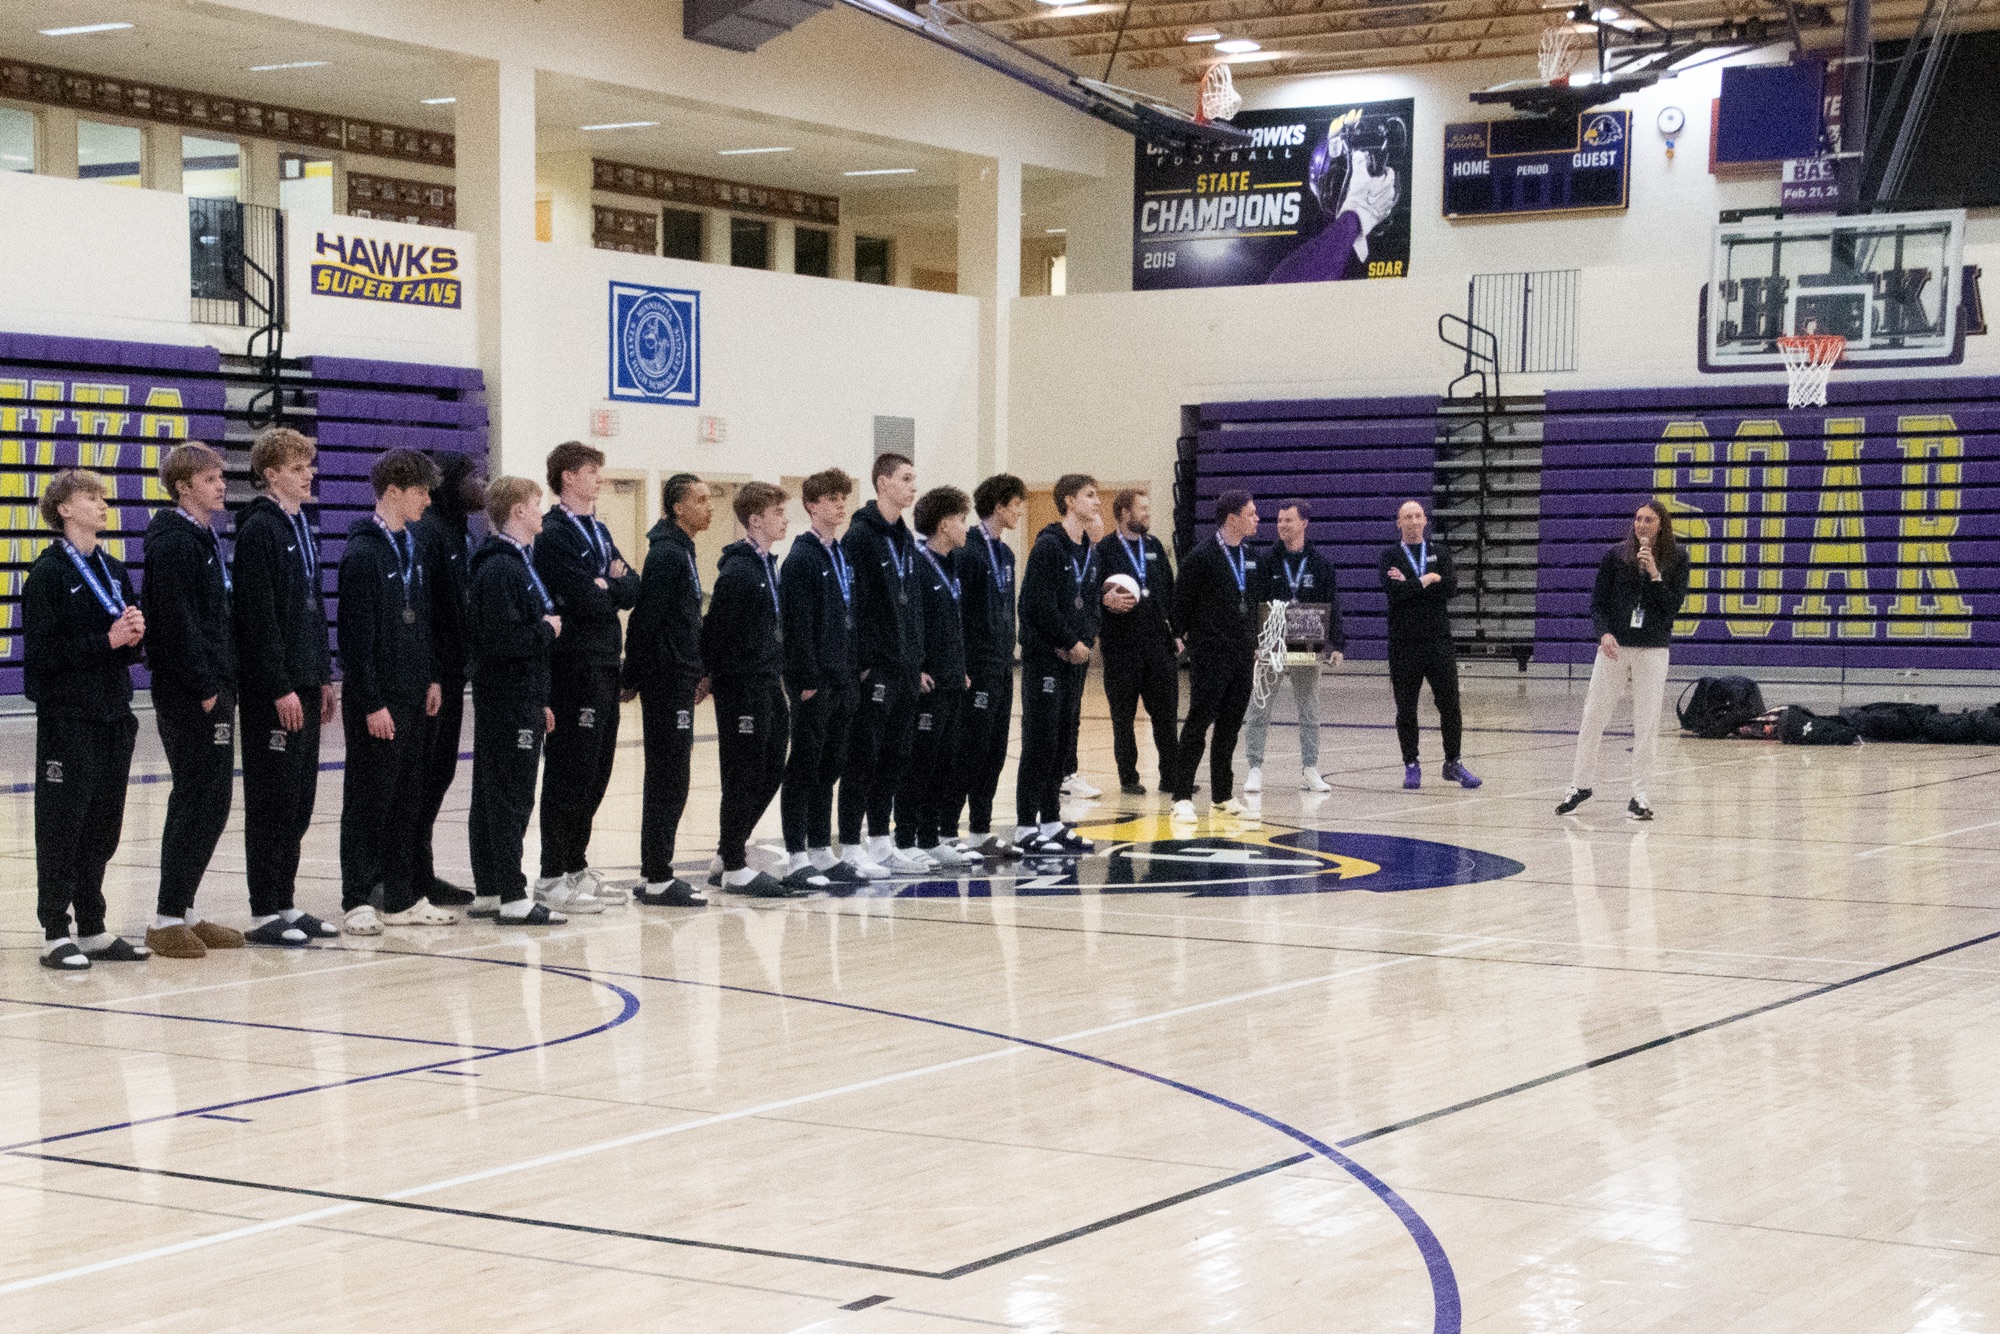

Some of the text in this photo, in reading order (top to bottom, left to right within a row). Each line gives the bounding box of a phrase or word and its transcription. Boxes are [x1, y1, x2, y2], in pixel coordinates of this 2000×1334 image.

[1243, 124, 1306, 147] AWKS
[1453, 160, 1491, 176] HOME
[1516, 163, 1549, 176] PERIOD
[1572, 151, 1617, 168] GUEST
[1196, 171, 1250, 193] STATE
[1141, 192, 1301, 233] CHAMPIONS
[316, 232, 458, 277] HAWKS
[1143, 252, 1177, 269] 2019
[1368, 261, 1402, 277] SOAR
[316, 269, 458, 304] SUPER FANS
[1653, 415, 1973, 639] SOAR
